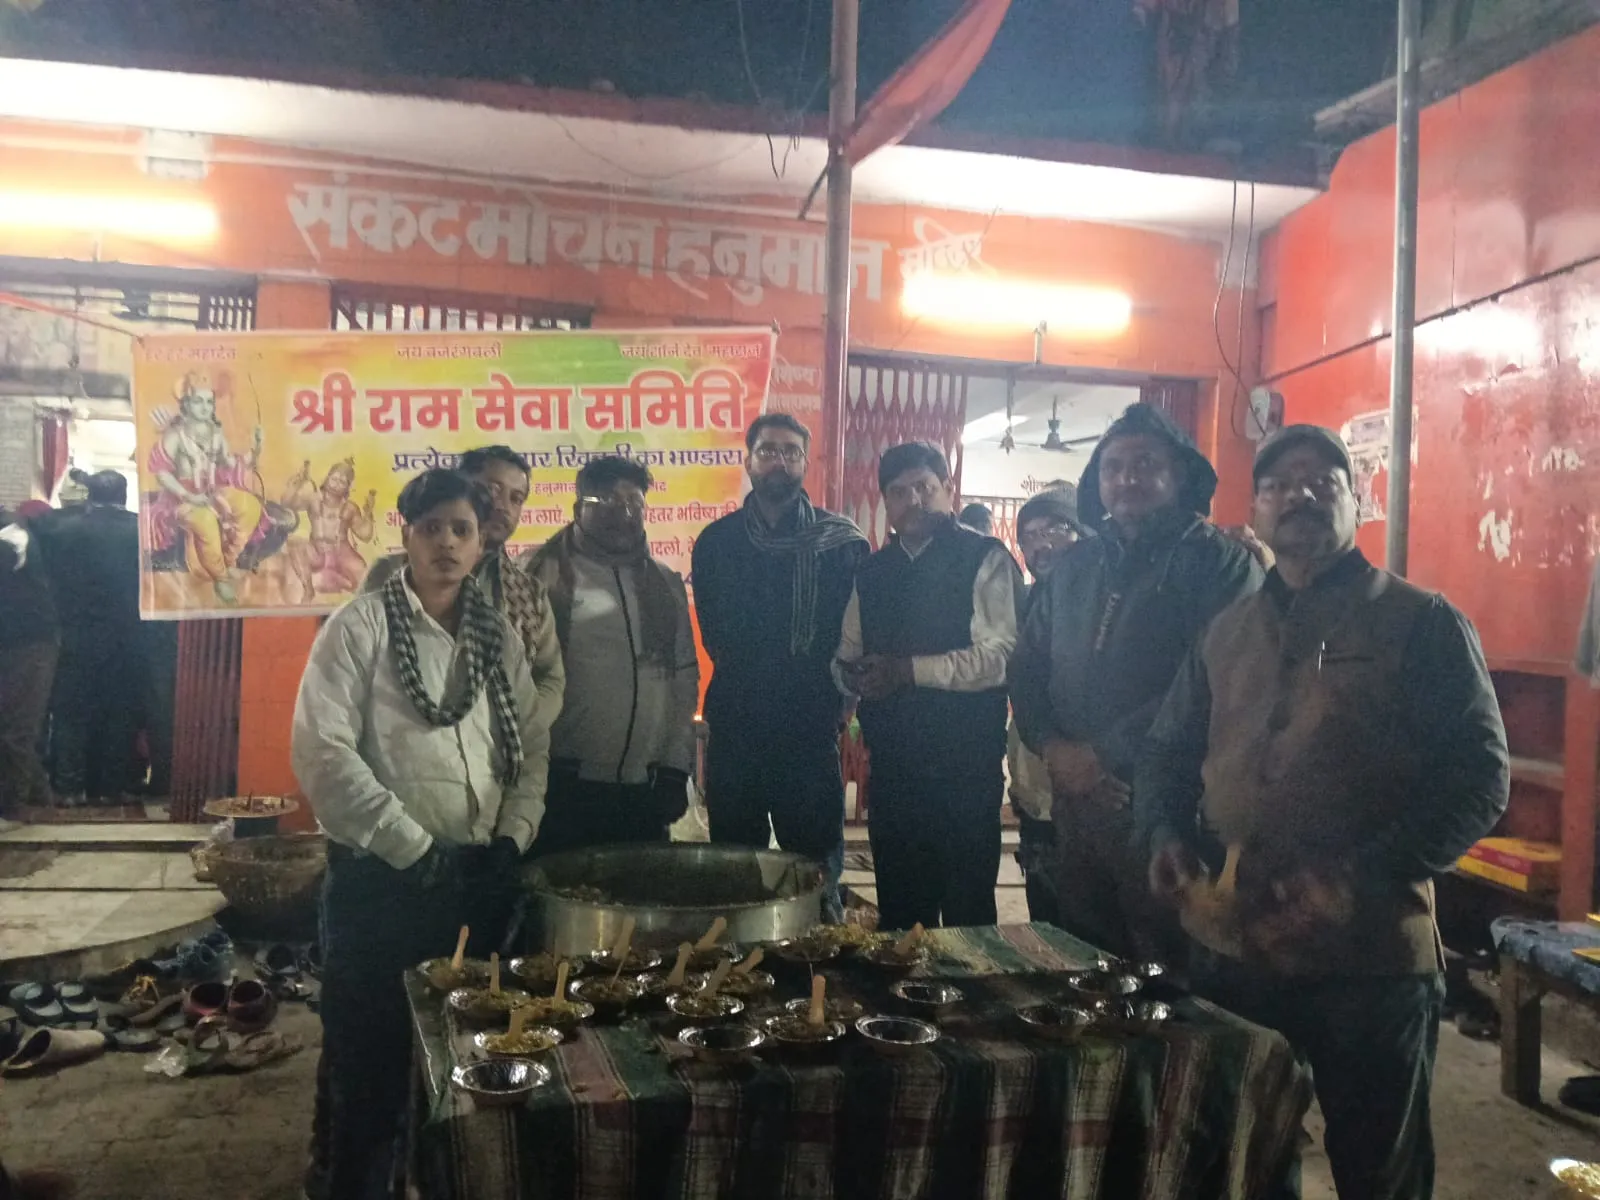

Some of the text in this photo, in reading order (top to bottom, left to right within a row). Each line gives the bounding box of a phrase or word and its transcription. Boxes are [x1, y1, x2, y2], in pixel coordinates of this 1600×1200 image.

[290, 372, 357, 433] श्री
[365, 389, 463, 433] राम
[472, 373, 573, 431] सेवा
[581, 370, 745, 431] समिति
[669, 449, 743, 467] भण्डारा
